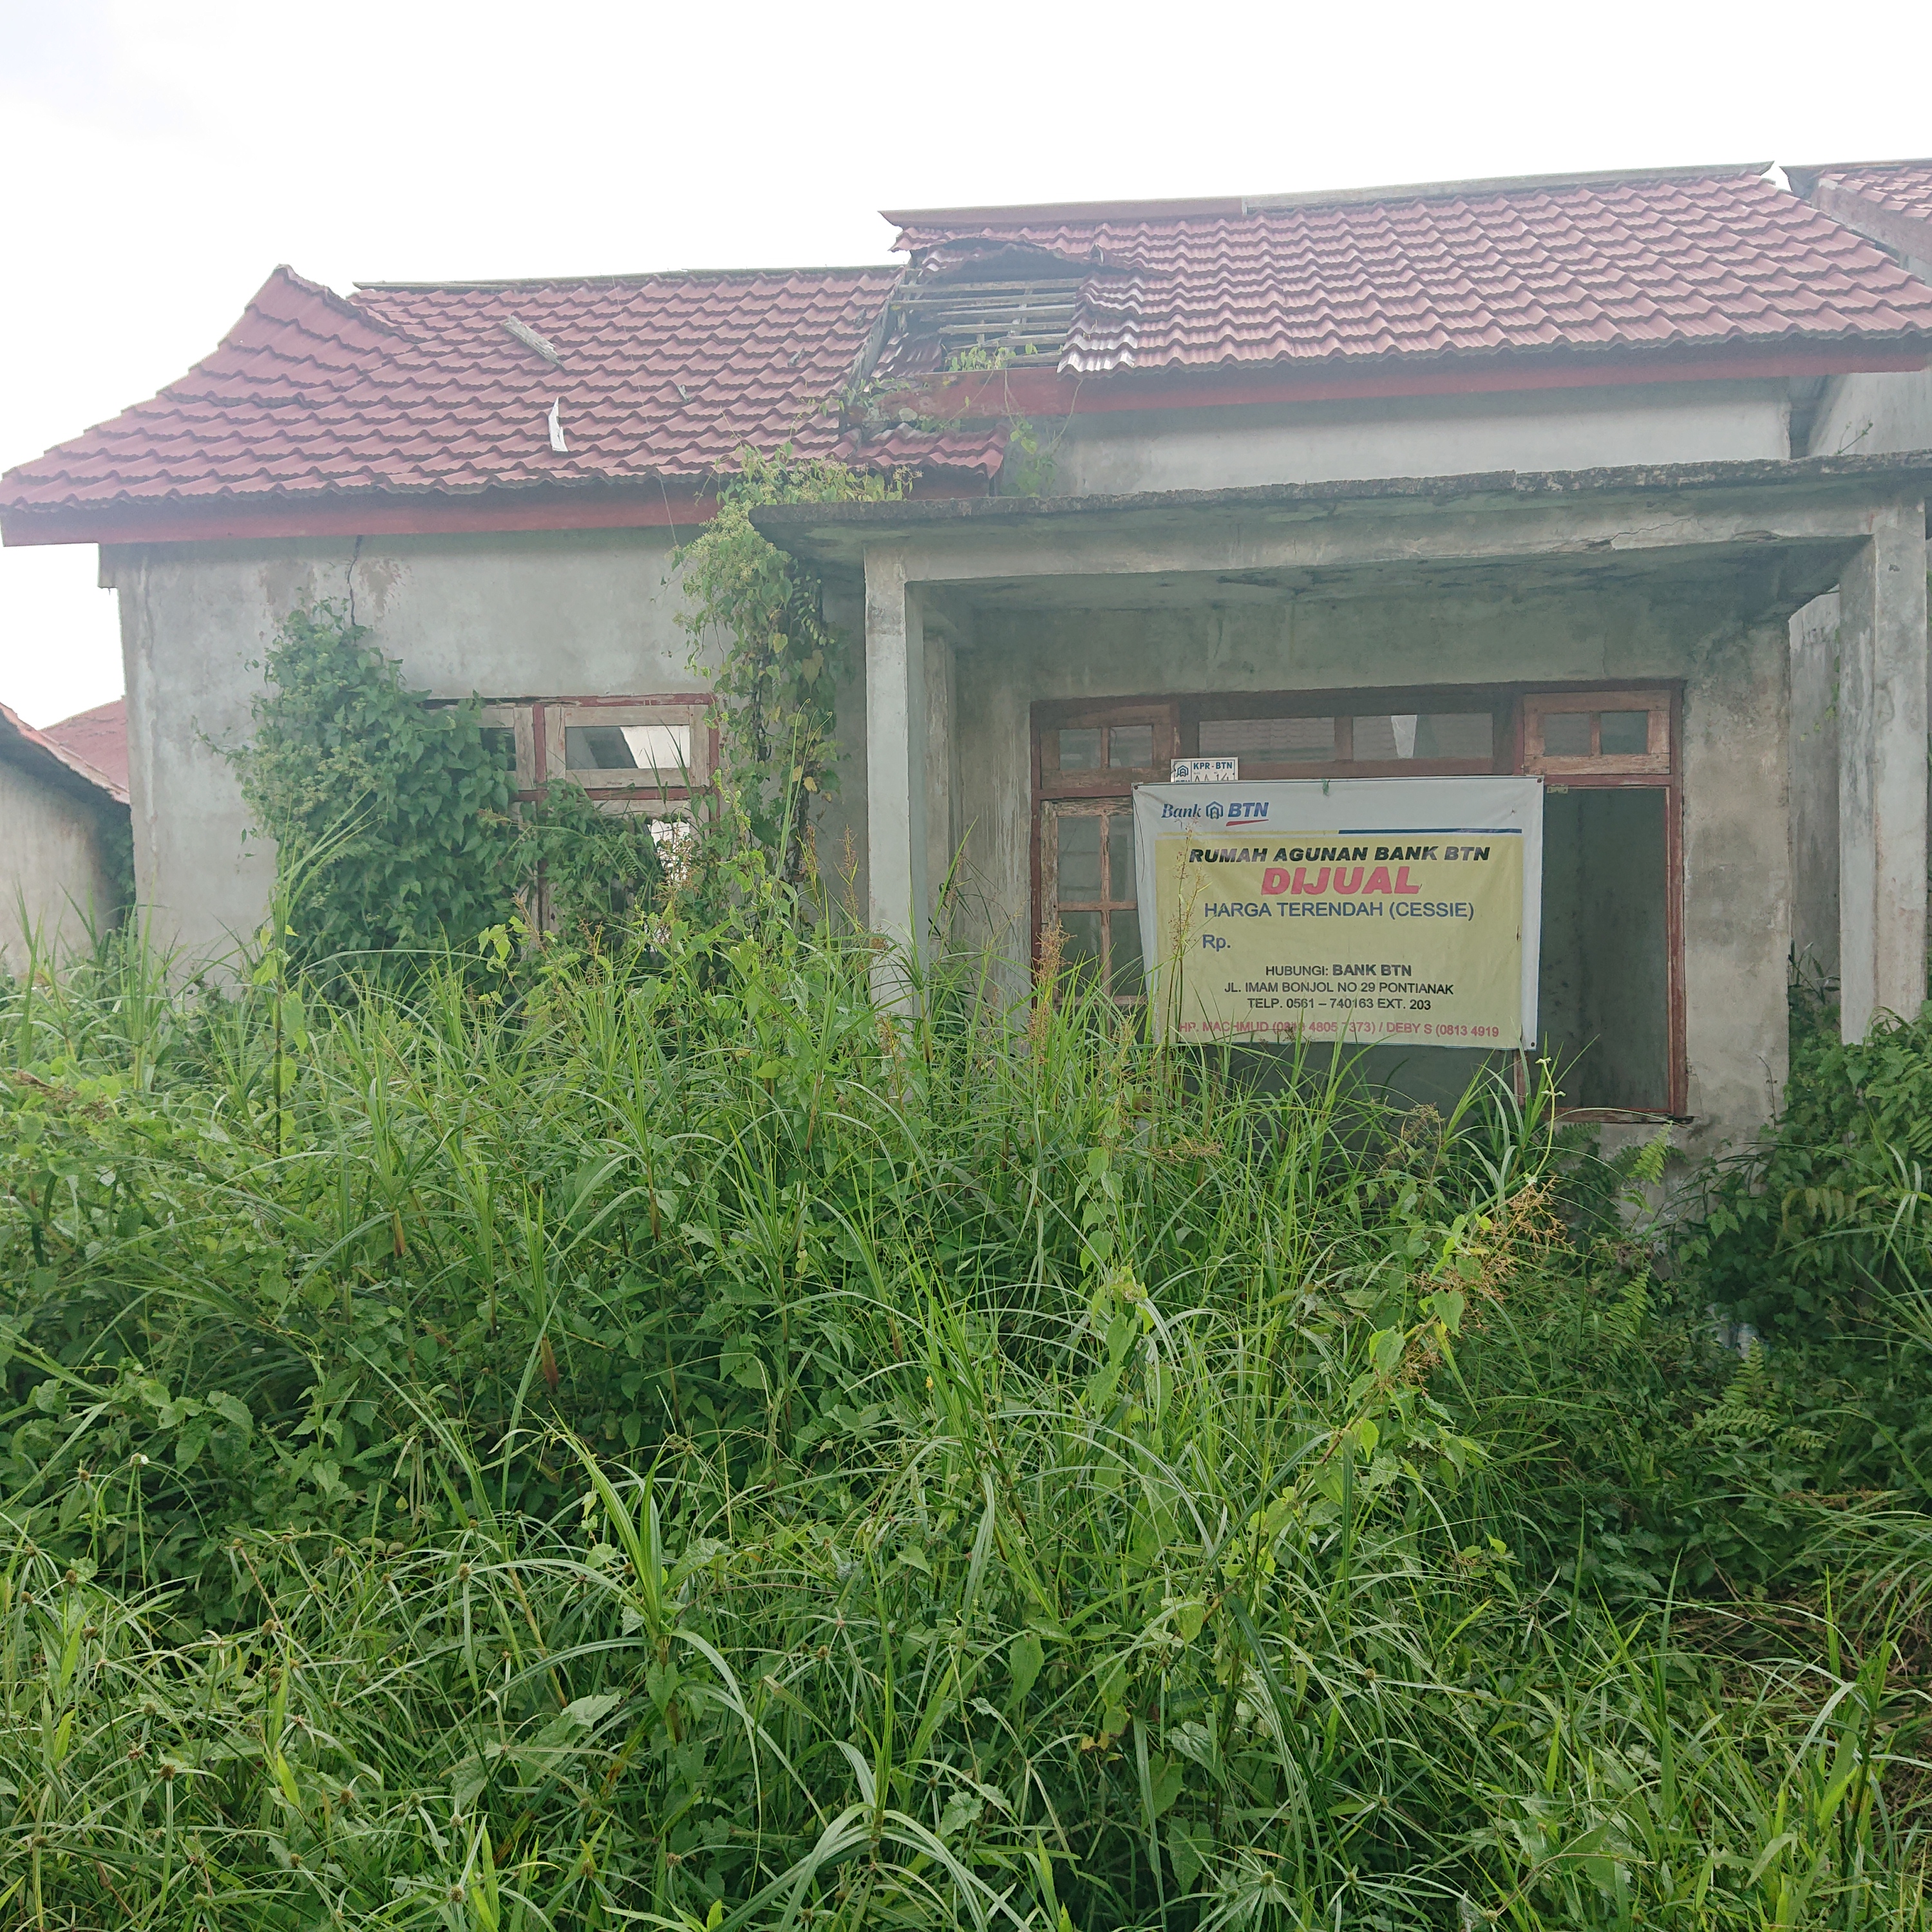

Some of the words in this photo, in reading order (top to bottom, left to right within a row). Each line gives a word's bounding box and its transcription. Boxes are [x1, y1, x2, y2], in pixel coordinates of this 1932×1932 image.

[1161, 804, 1201, 819] Bank
[1227, 802, 1269, 818] BTN
[1189, 848, 1268, 863] RUMAH
[1273, 847, 1368, 862] AGUNAN
[1374, 846, 1439, 860] BANK
[1444, 846, 1490, 861] BTN
[1261, 866, 1419, 895] DIJUAL
[1204, 902, 1272, 917] HARGA
[1276, 902, 1383, 916] TERENDAH
[1389, 902, 1474, 921] (CESSIE)
[1202, 934, 1231, 952] Rp.
[1265, 965, 1329, 976] HUBUNGI:
[1332, 964, 1377, 976] BANK
[1381, 965, 1412, 976] BTN
[1224, 982, 1242, 992] JL.
[1245, 982, 1278, 992] IMAM
[1282, 982, 1334, 992] BONJOL
[1338, 982, 1357, 992] NO
[1361, 982, 1376, 992] 29
[1379, 982, 1454, 995] PONTIANAK
[1247, 998, 1283, 1009] TELP.
[1286, 998, 1314, 1009] 0561
[1330, 998, 1374, 1009] 740163
[1378, 998, 1406, 1009] EXT.
[1410, 999, 1431, 1010] 203
[1202, 1021, 1269, 1032] MACHMUD
[1309, 1021, 1338, 1032] 4805
[1387, 1022, 1421, 1034] DEBY
[1424, 1024, 1432, 1034] S
[1435, 1024, 1468, 1037] (0813
[1470, 1026, 1499, 1037] 4919
